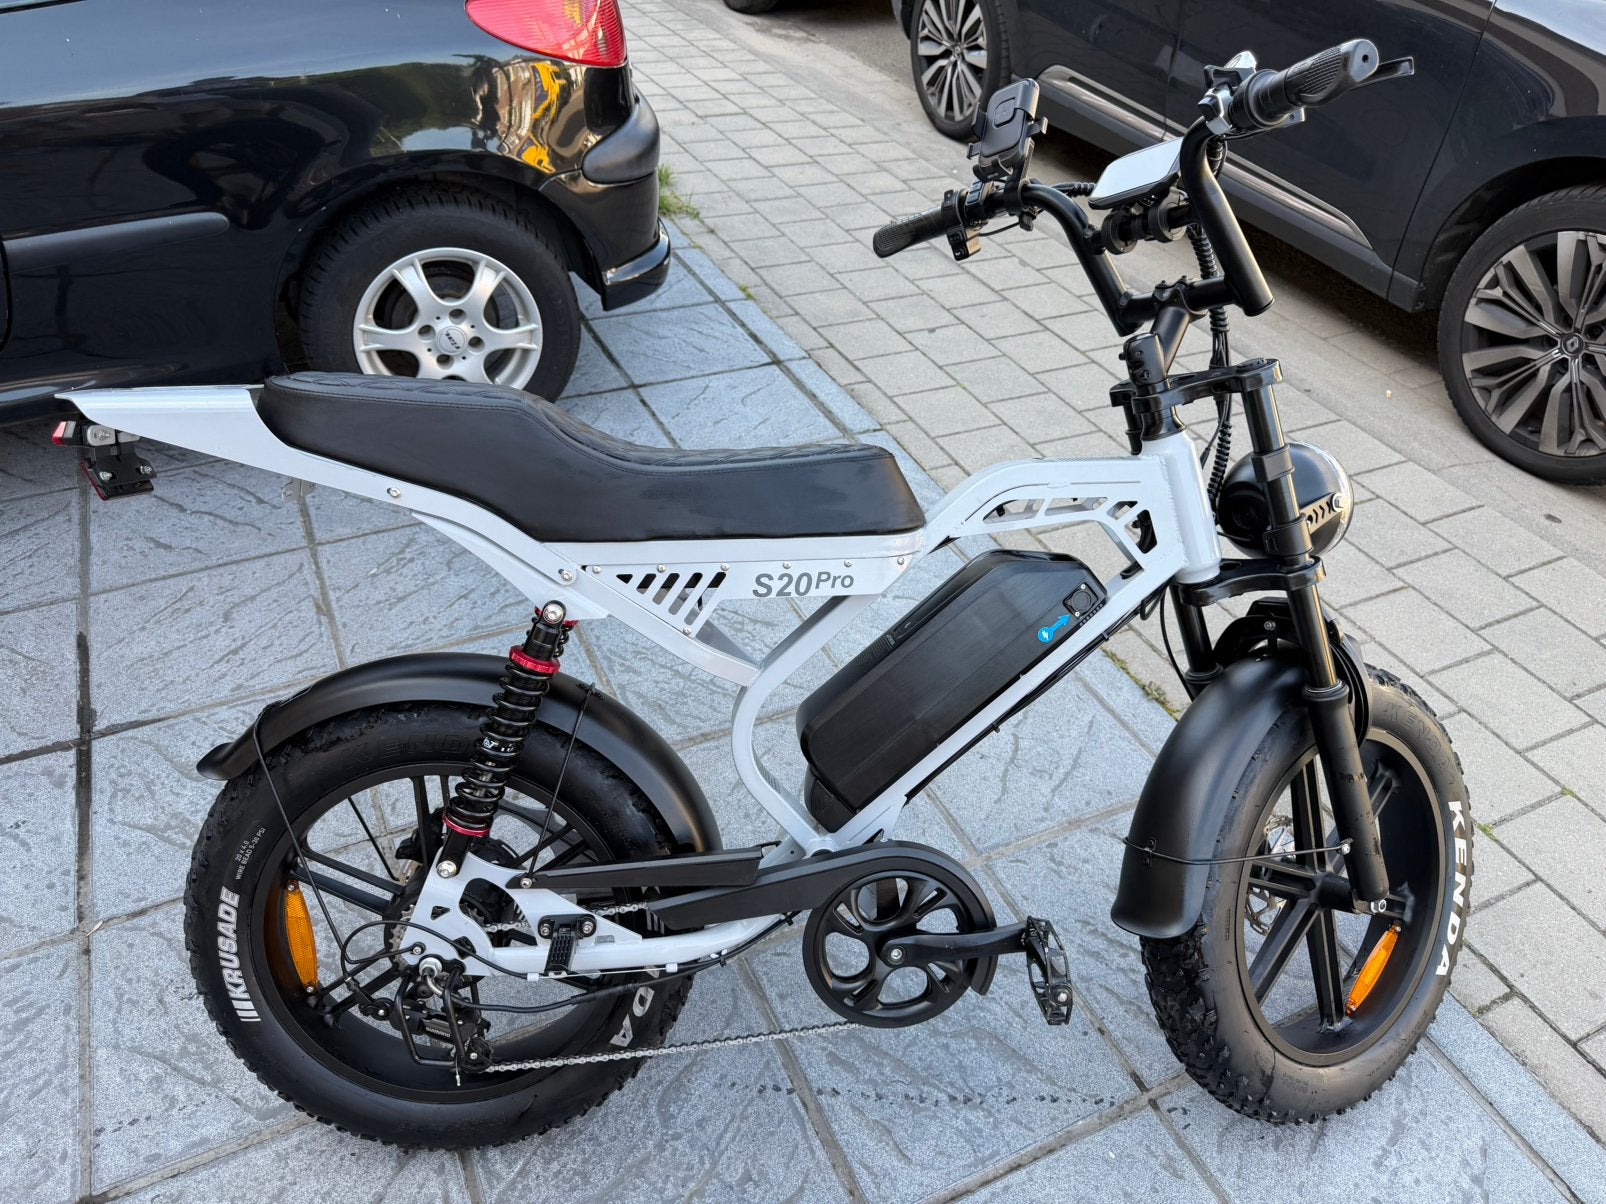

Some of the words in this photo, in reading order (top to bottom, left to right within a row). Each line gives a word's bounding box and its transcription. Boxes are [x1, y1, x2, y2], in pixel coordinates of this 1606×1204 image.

[235, 865, 246, 880] WIRE
[241, 849, 252, 865] BEAD
[256, 827, 266, 837] PSI
[1435, 801, 1467, 976] KENDA
[217, 886, 250, 999] KRUSADE
